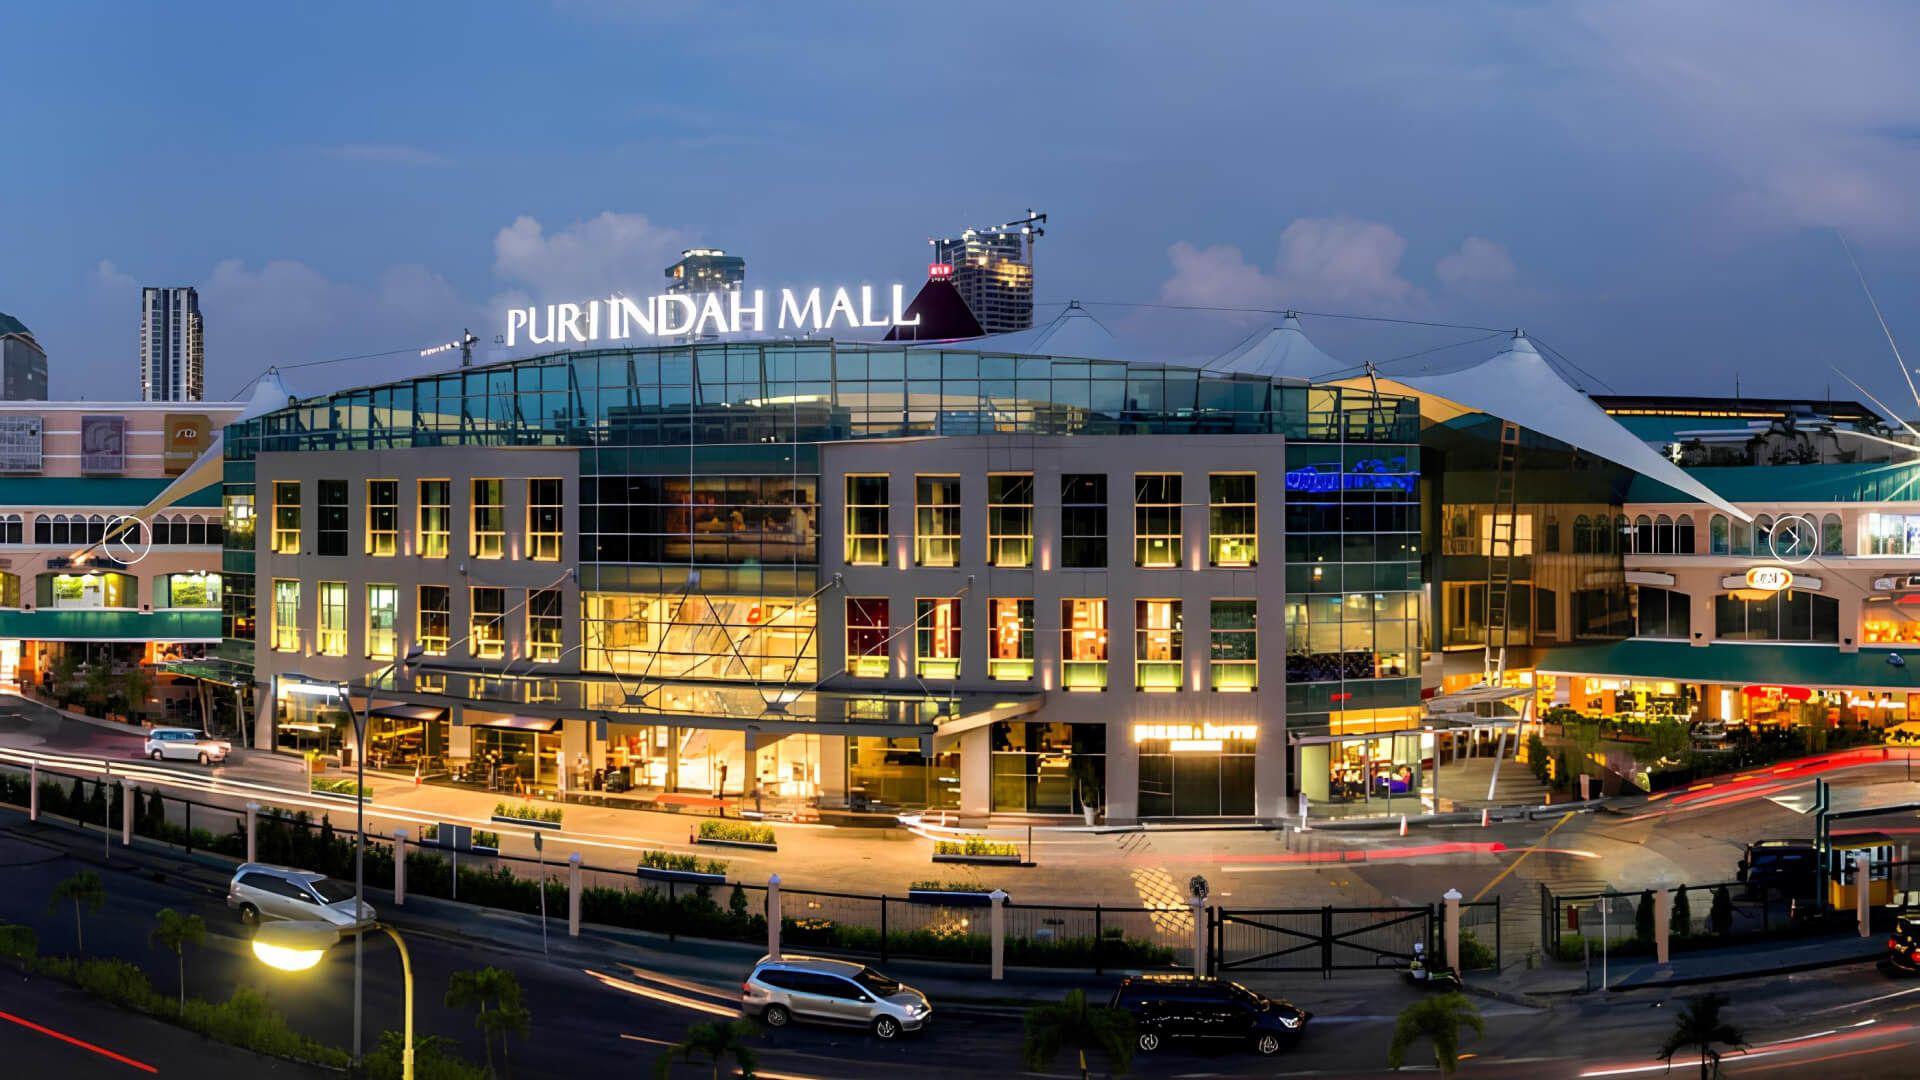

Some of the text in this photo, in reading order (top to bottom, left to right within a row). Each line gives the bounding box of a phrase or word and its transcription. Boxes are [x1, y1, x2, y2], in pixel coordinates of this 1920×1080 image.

[506, 284, 921, 347] PURI INDAH MALL
